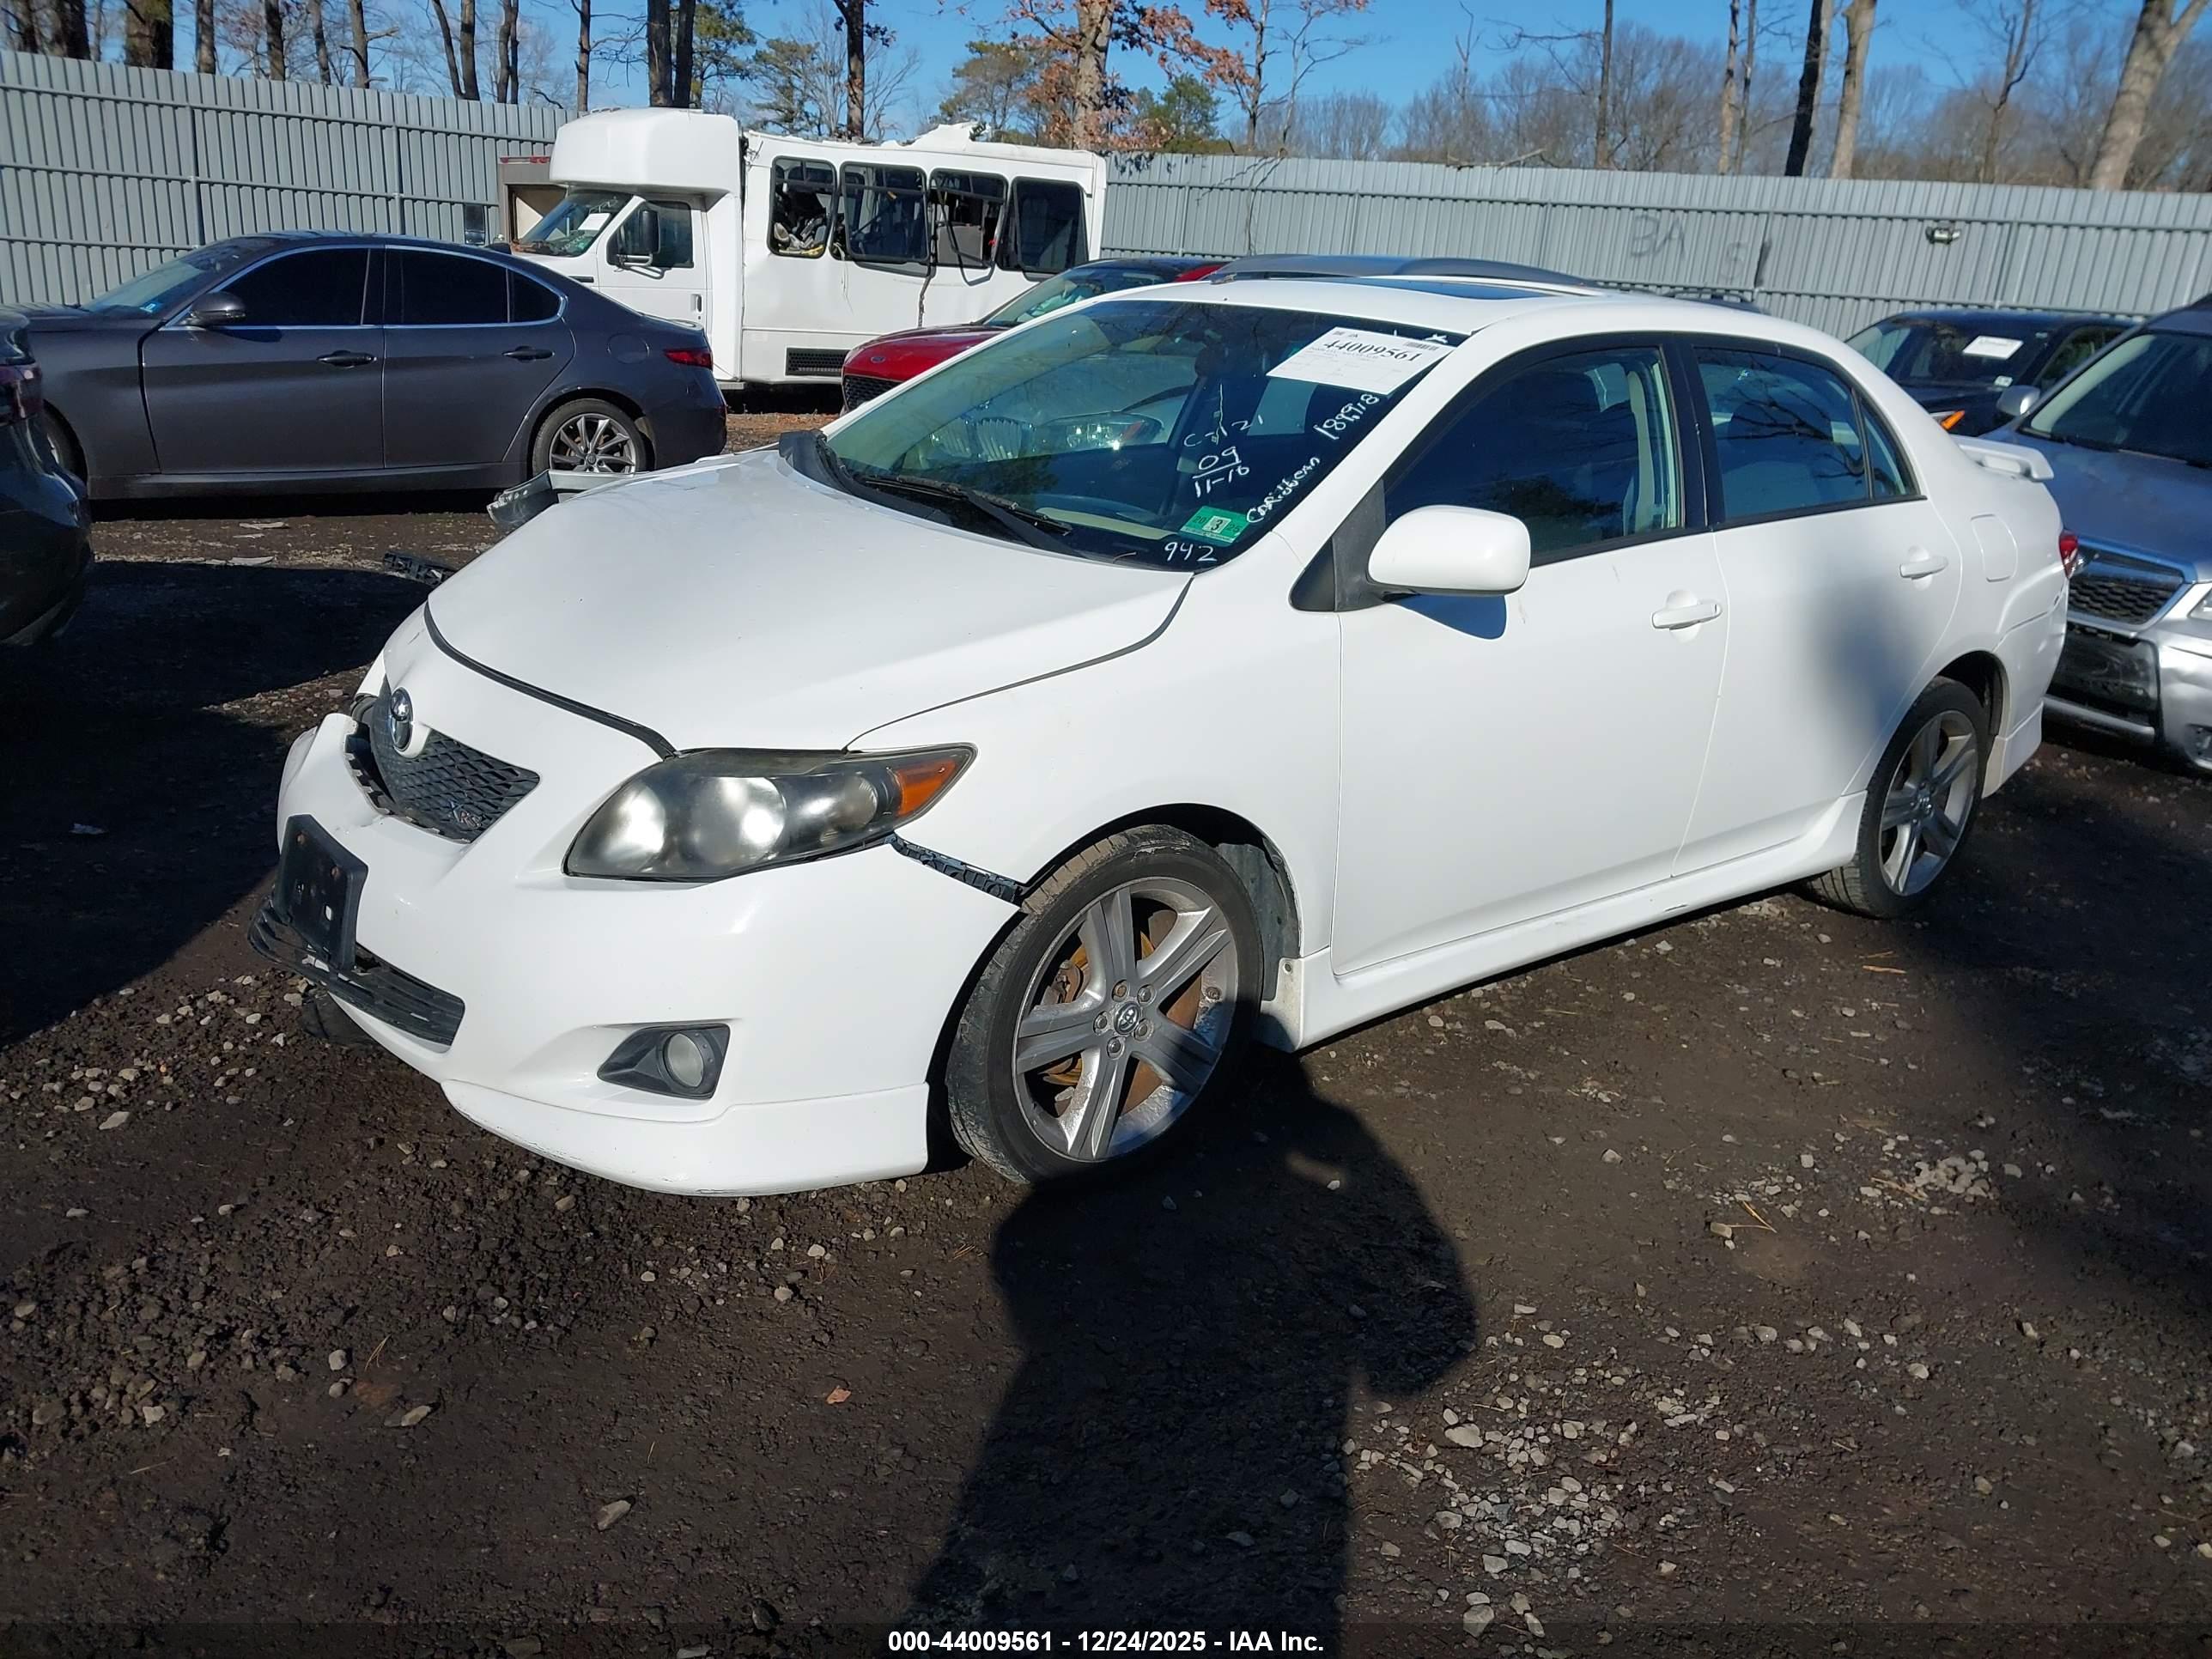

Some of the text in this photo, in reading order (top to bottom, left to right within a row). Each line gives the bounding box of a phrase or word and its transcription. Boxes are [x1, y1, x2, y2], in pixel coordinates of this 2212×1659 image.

[1323, 338, 1422, 362] 44009561
[1211, 520, 1223, 531] 3
[1164, 542, 1218, 562] 942
